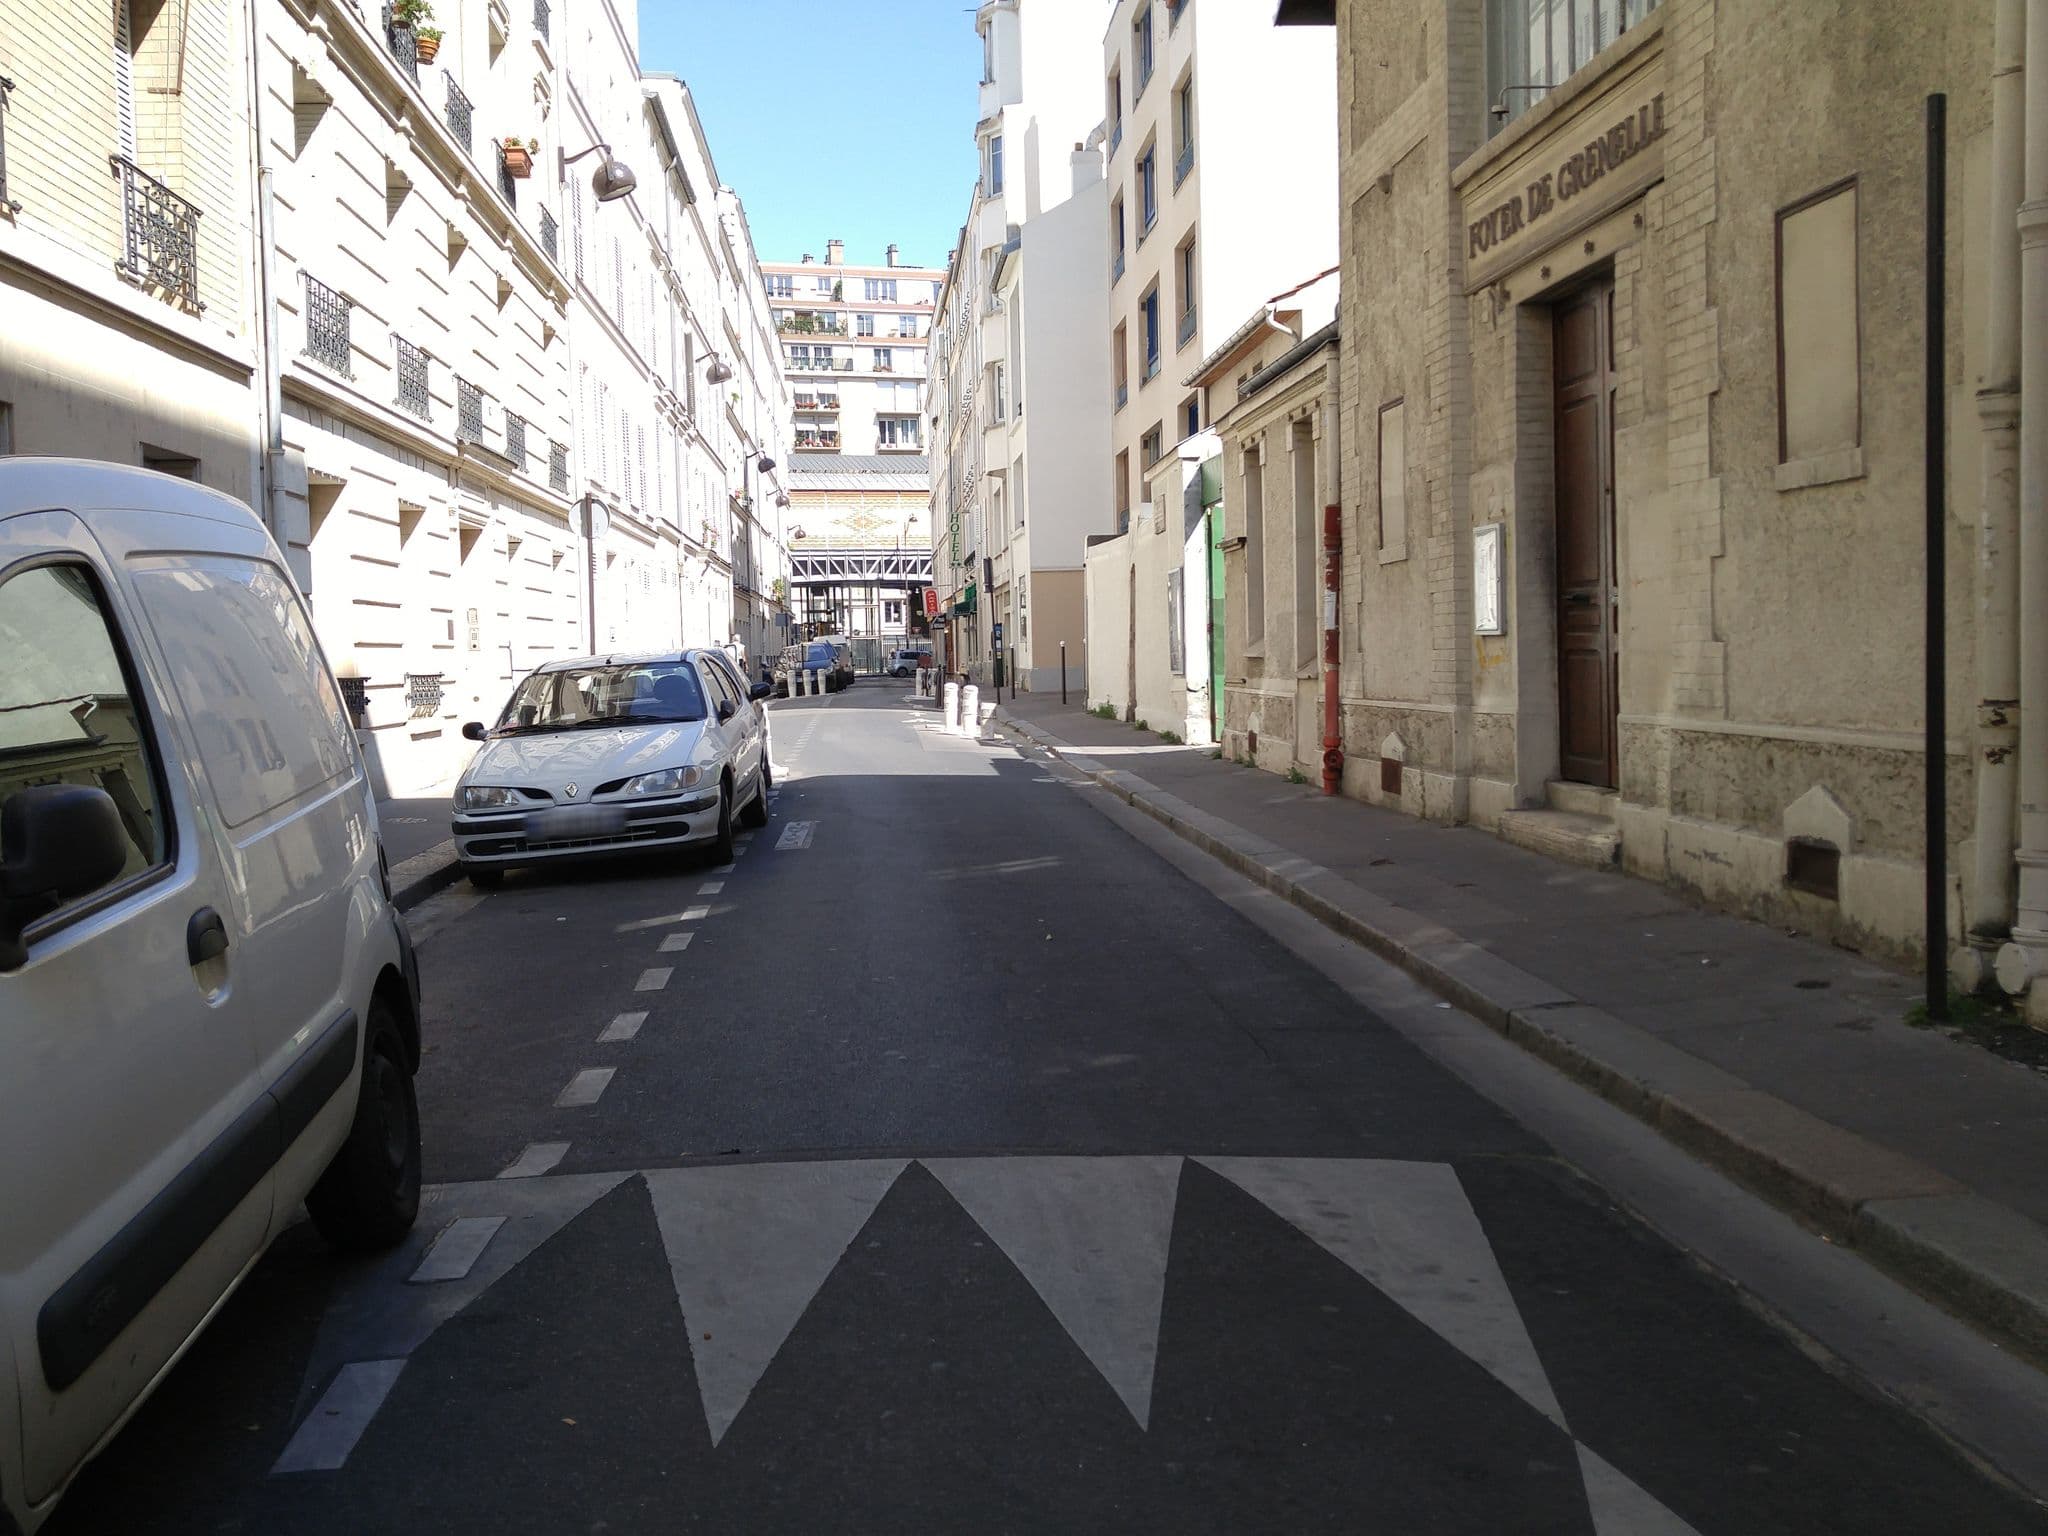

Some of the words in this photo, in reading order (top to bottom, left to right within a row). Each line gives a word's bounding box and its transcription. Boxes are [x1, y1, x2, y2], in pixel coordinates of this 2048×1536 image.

[1469, 196, 1524, 259] FOYER
[1526, 172, 1554, 223] DE
[950, 513, 960, 562] HOTEL
